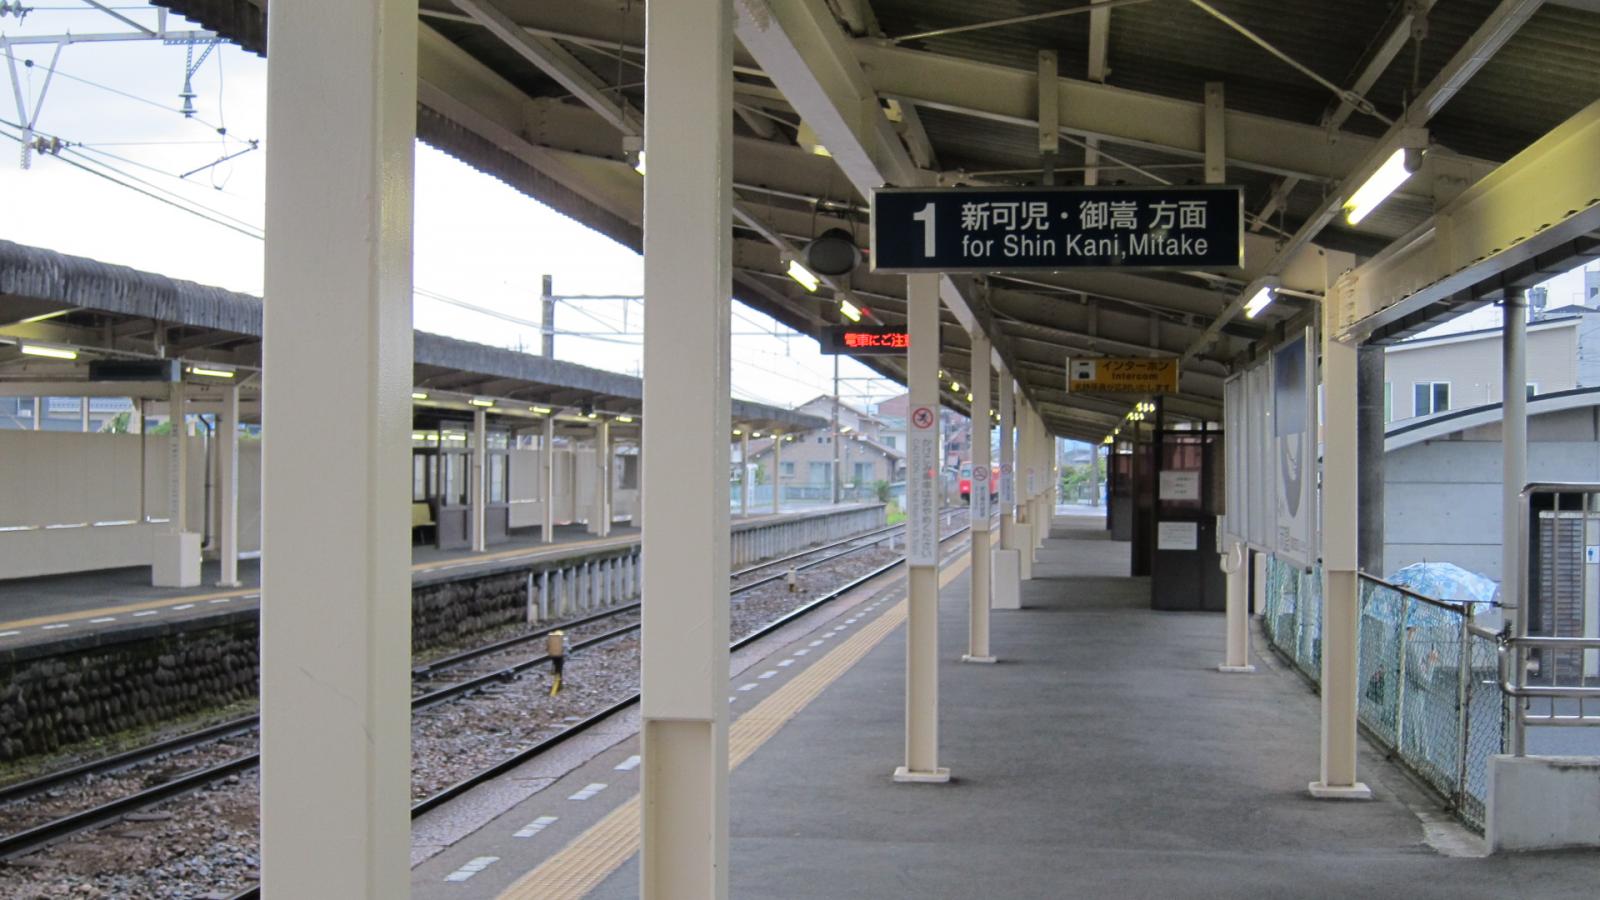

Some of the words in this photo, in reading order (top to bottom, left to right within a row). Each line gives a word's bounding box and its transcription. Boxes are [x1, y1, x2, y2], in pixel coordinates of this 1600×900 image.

[913, 202, 936, 258] 1
[962, 234, 995, 257] for
[1003, 234, 1056, 257] Shin
[1102, 360, 1169, 372] インターホン
